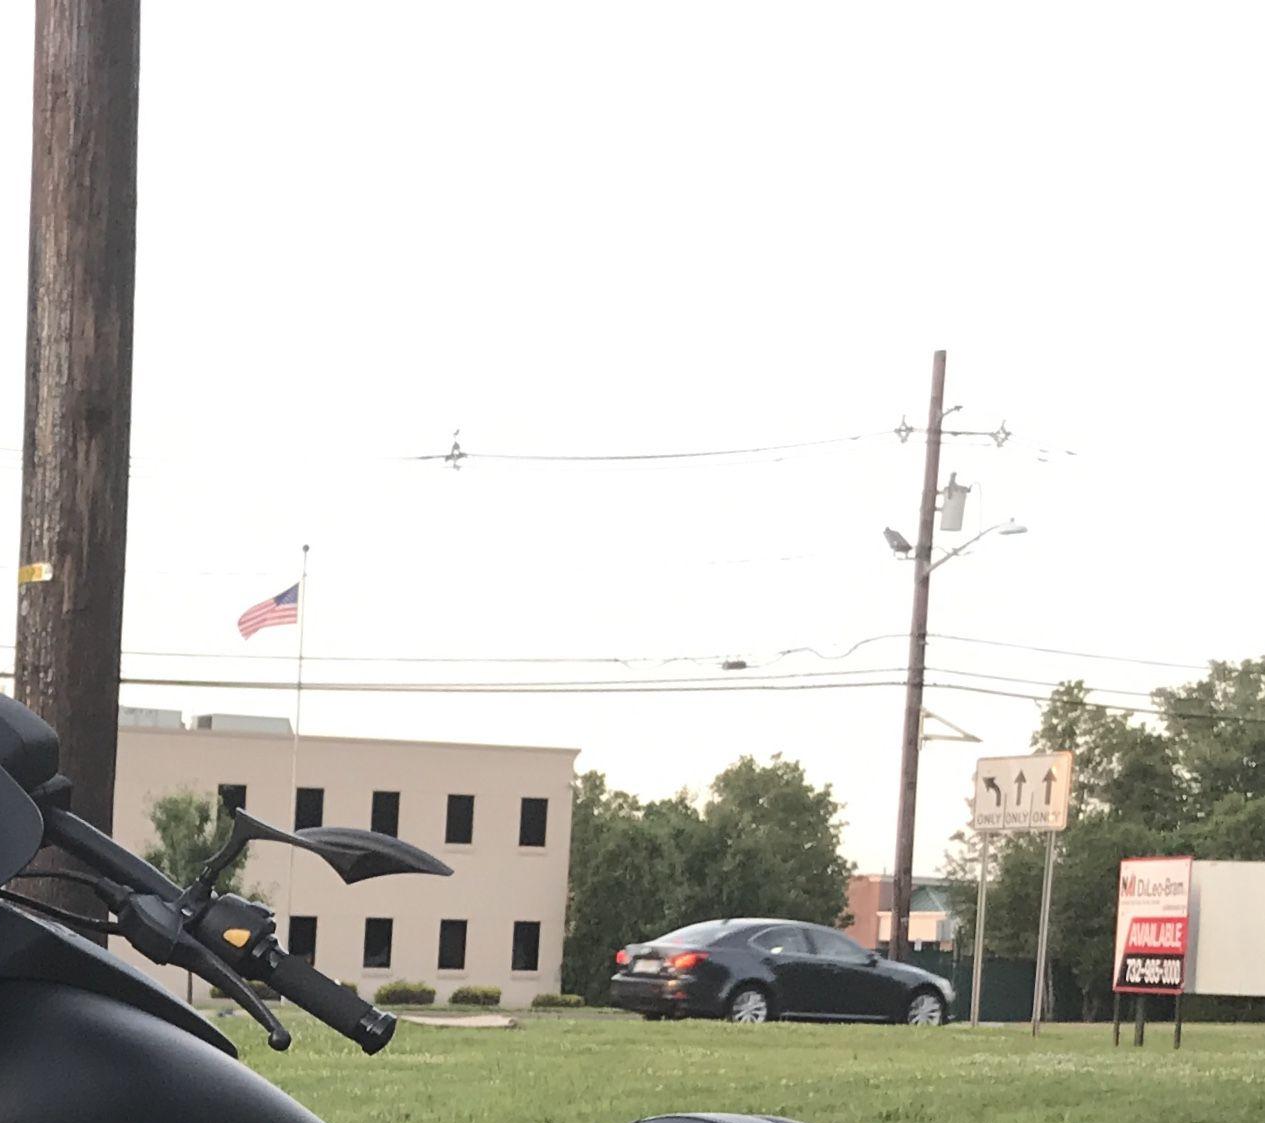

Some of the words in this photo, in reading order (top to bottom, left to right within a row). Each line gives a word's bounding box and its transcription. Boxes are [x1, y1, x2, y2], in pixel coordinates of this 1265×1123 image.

[977, 813, 1002, 825] ONLY
[1006, 811, 1028, 824] ONLY
[1128, 921, 1183, 948] AVAILABLE
